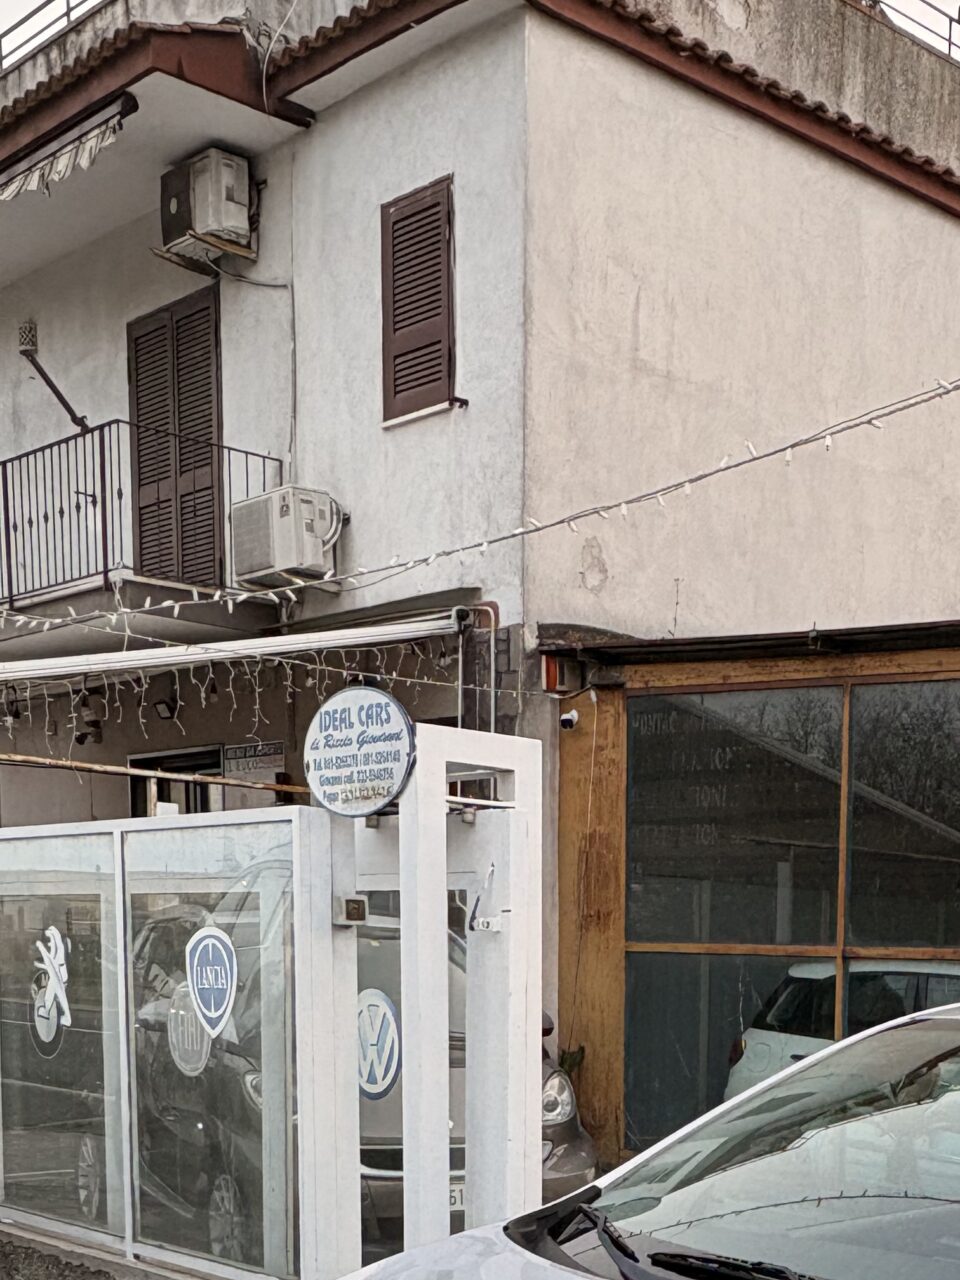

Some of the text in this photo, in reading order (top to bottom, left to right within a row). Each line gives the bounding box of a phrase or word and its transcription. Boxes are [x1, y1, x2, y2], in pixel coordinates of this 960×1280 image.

[319, 702, 391, 733] IDEAL CARS
[197, 965, 227, 989] LANCIA
